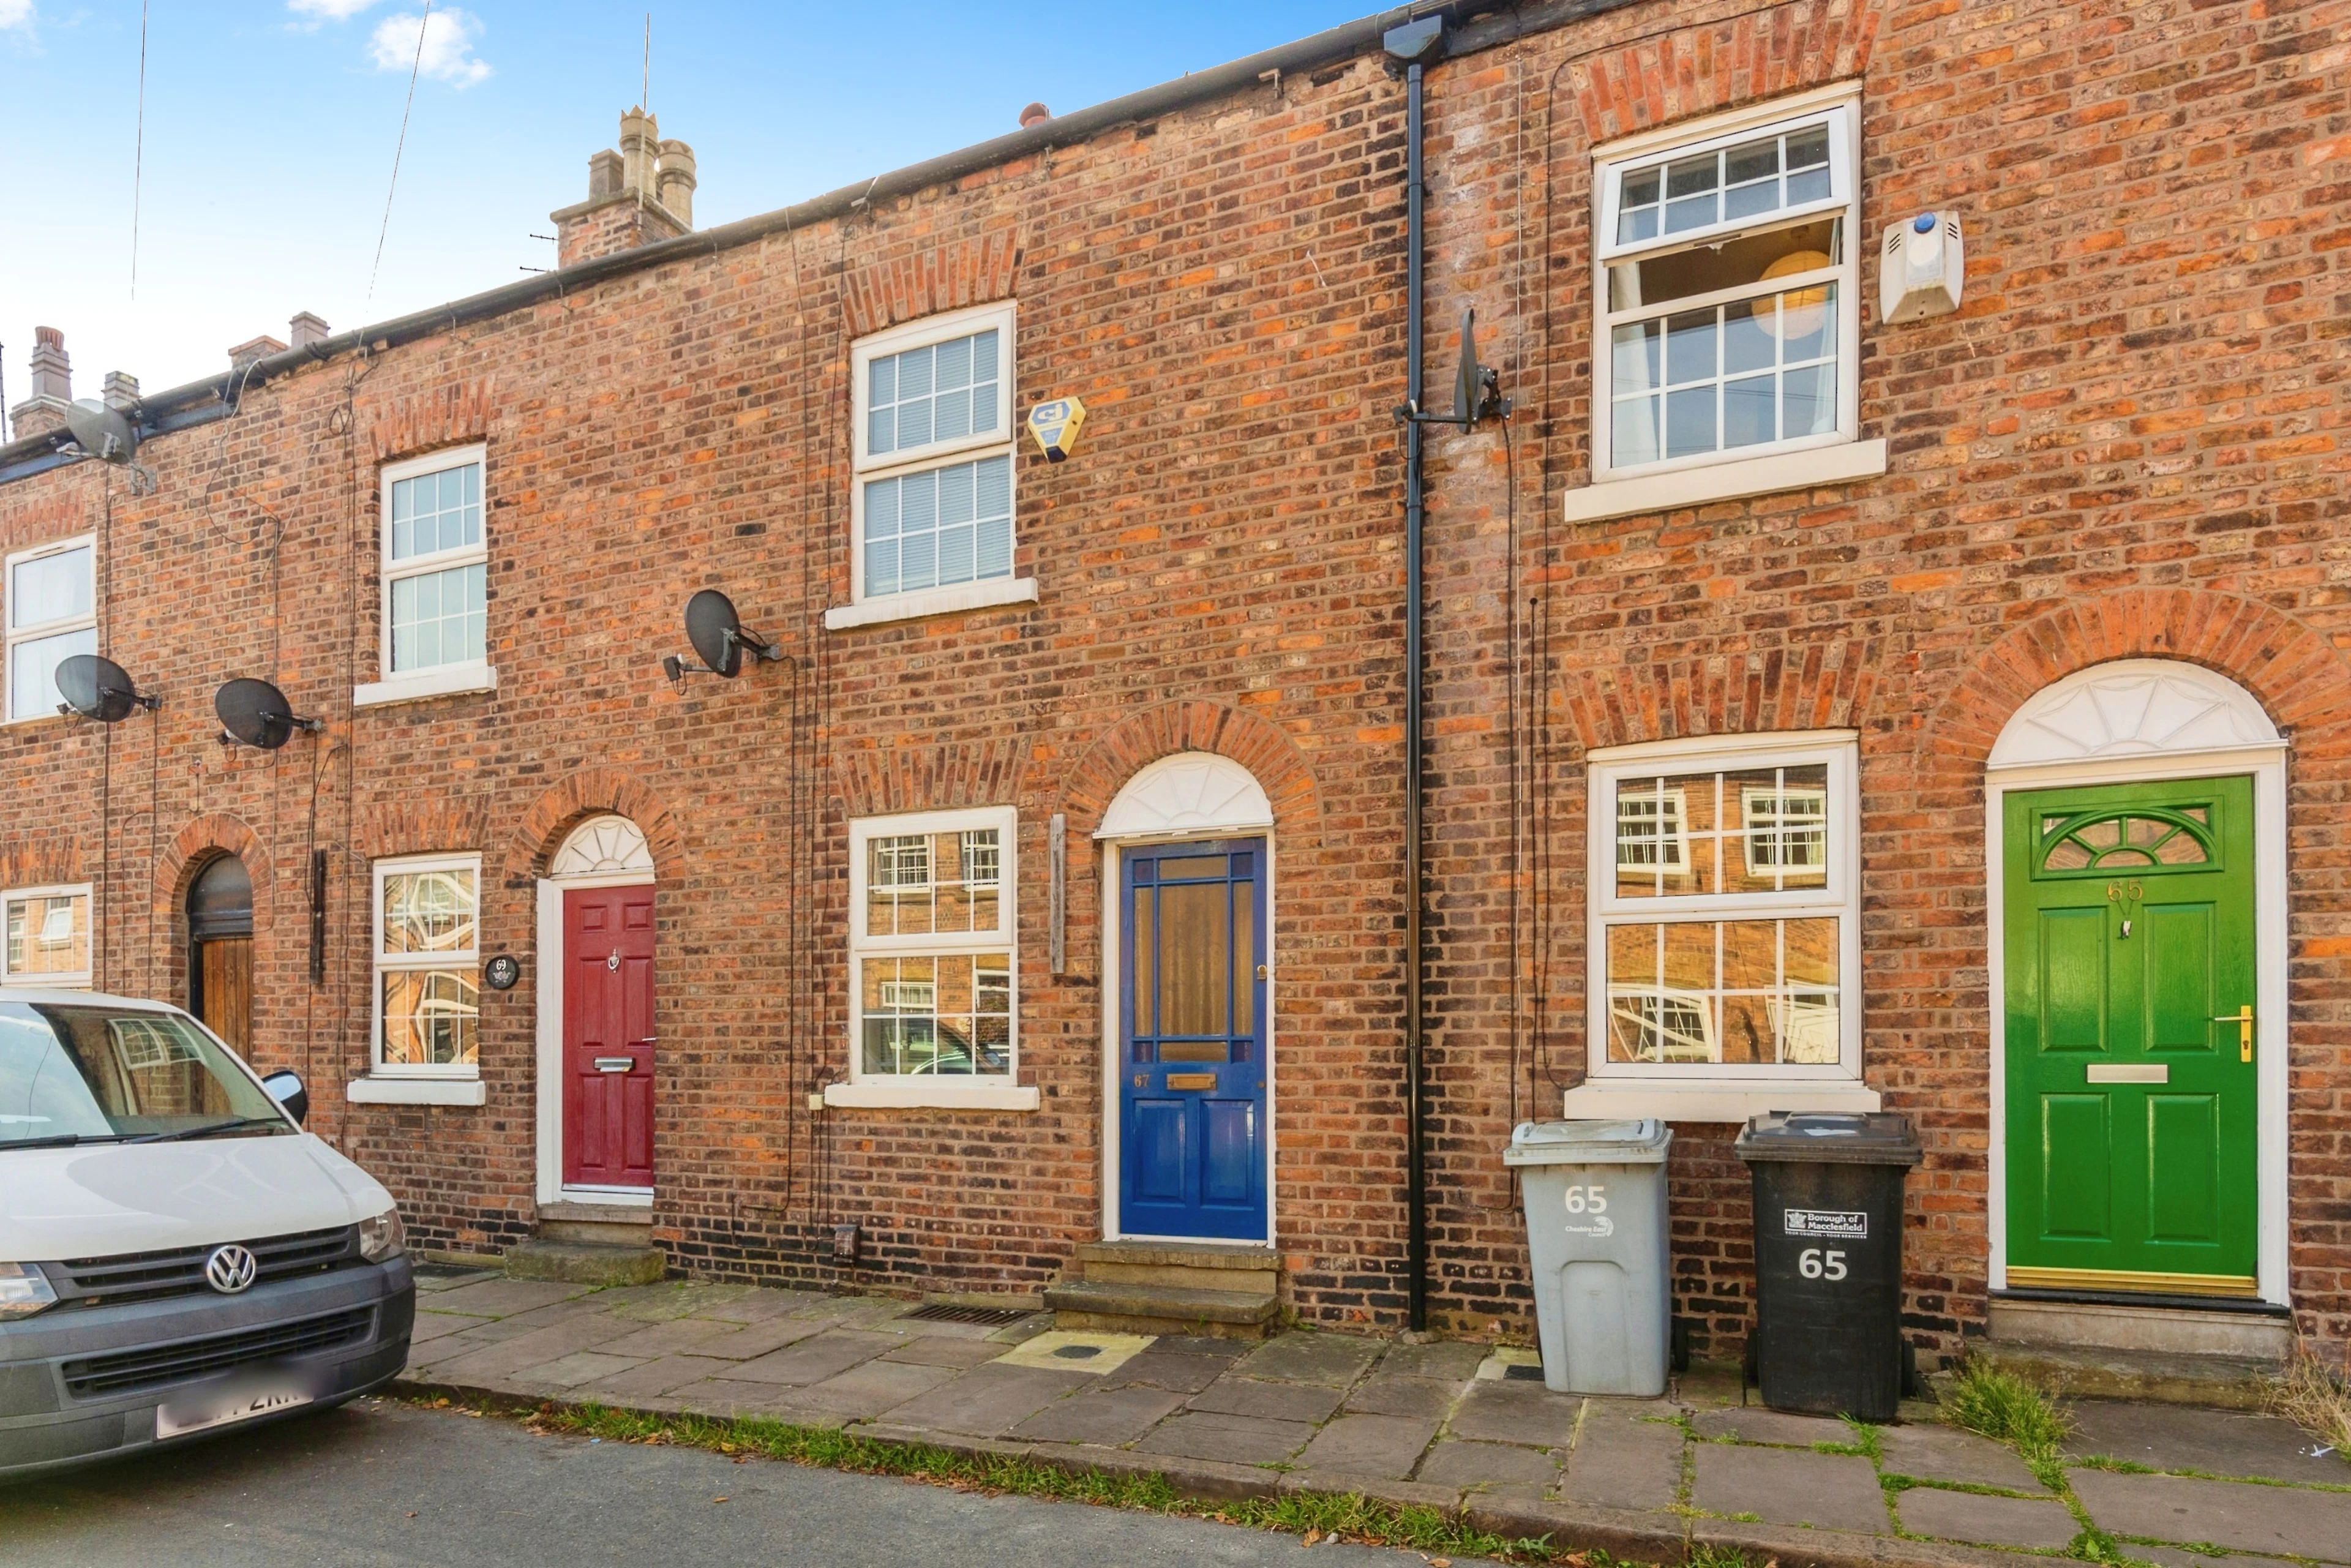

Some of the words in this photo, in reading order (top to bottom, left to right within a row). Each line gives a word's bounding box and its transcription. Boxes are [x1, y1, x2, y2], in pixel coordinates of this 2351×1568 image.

[2107, 879, 2143, 902] 65
[496, 959, 507, 970] 69
[1133, 1073, 1150, 1088] 67
[1565, 1185, 1607, 1214] 65
[1807, 1213, 1847, 1224] Borough
[1807, 1221, 1862, 1232] Macclesfield
[1799, 1248, 1848, 1281] 65
